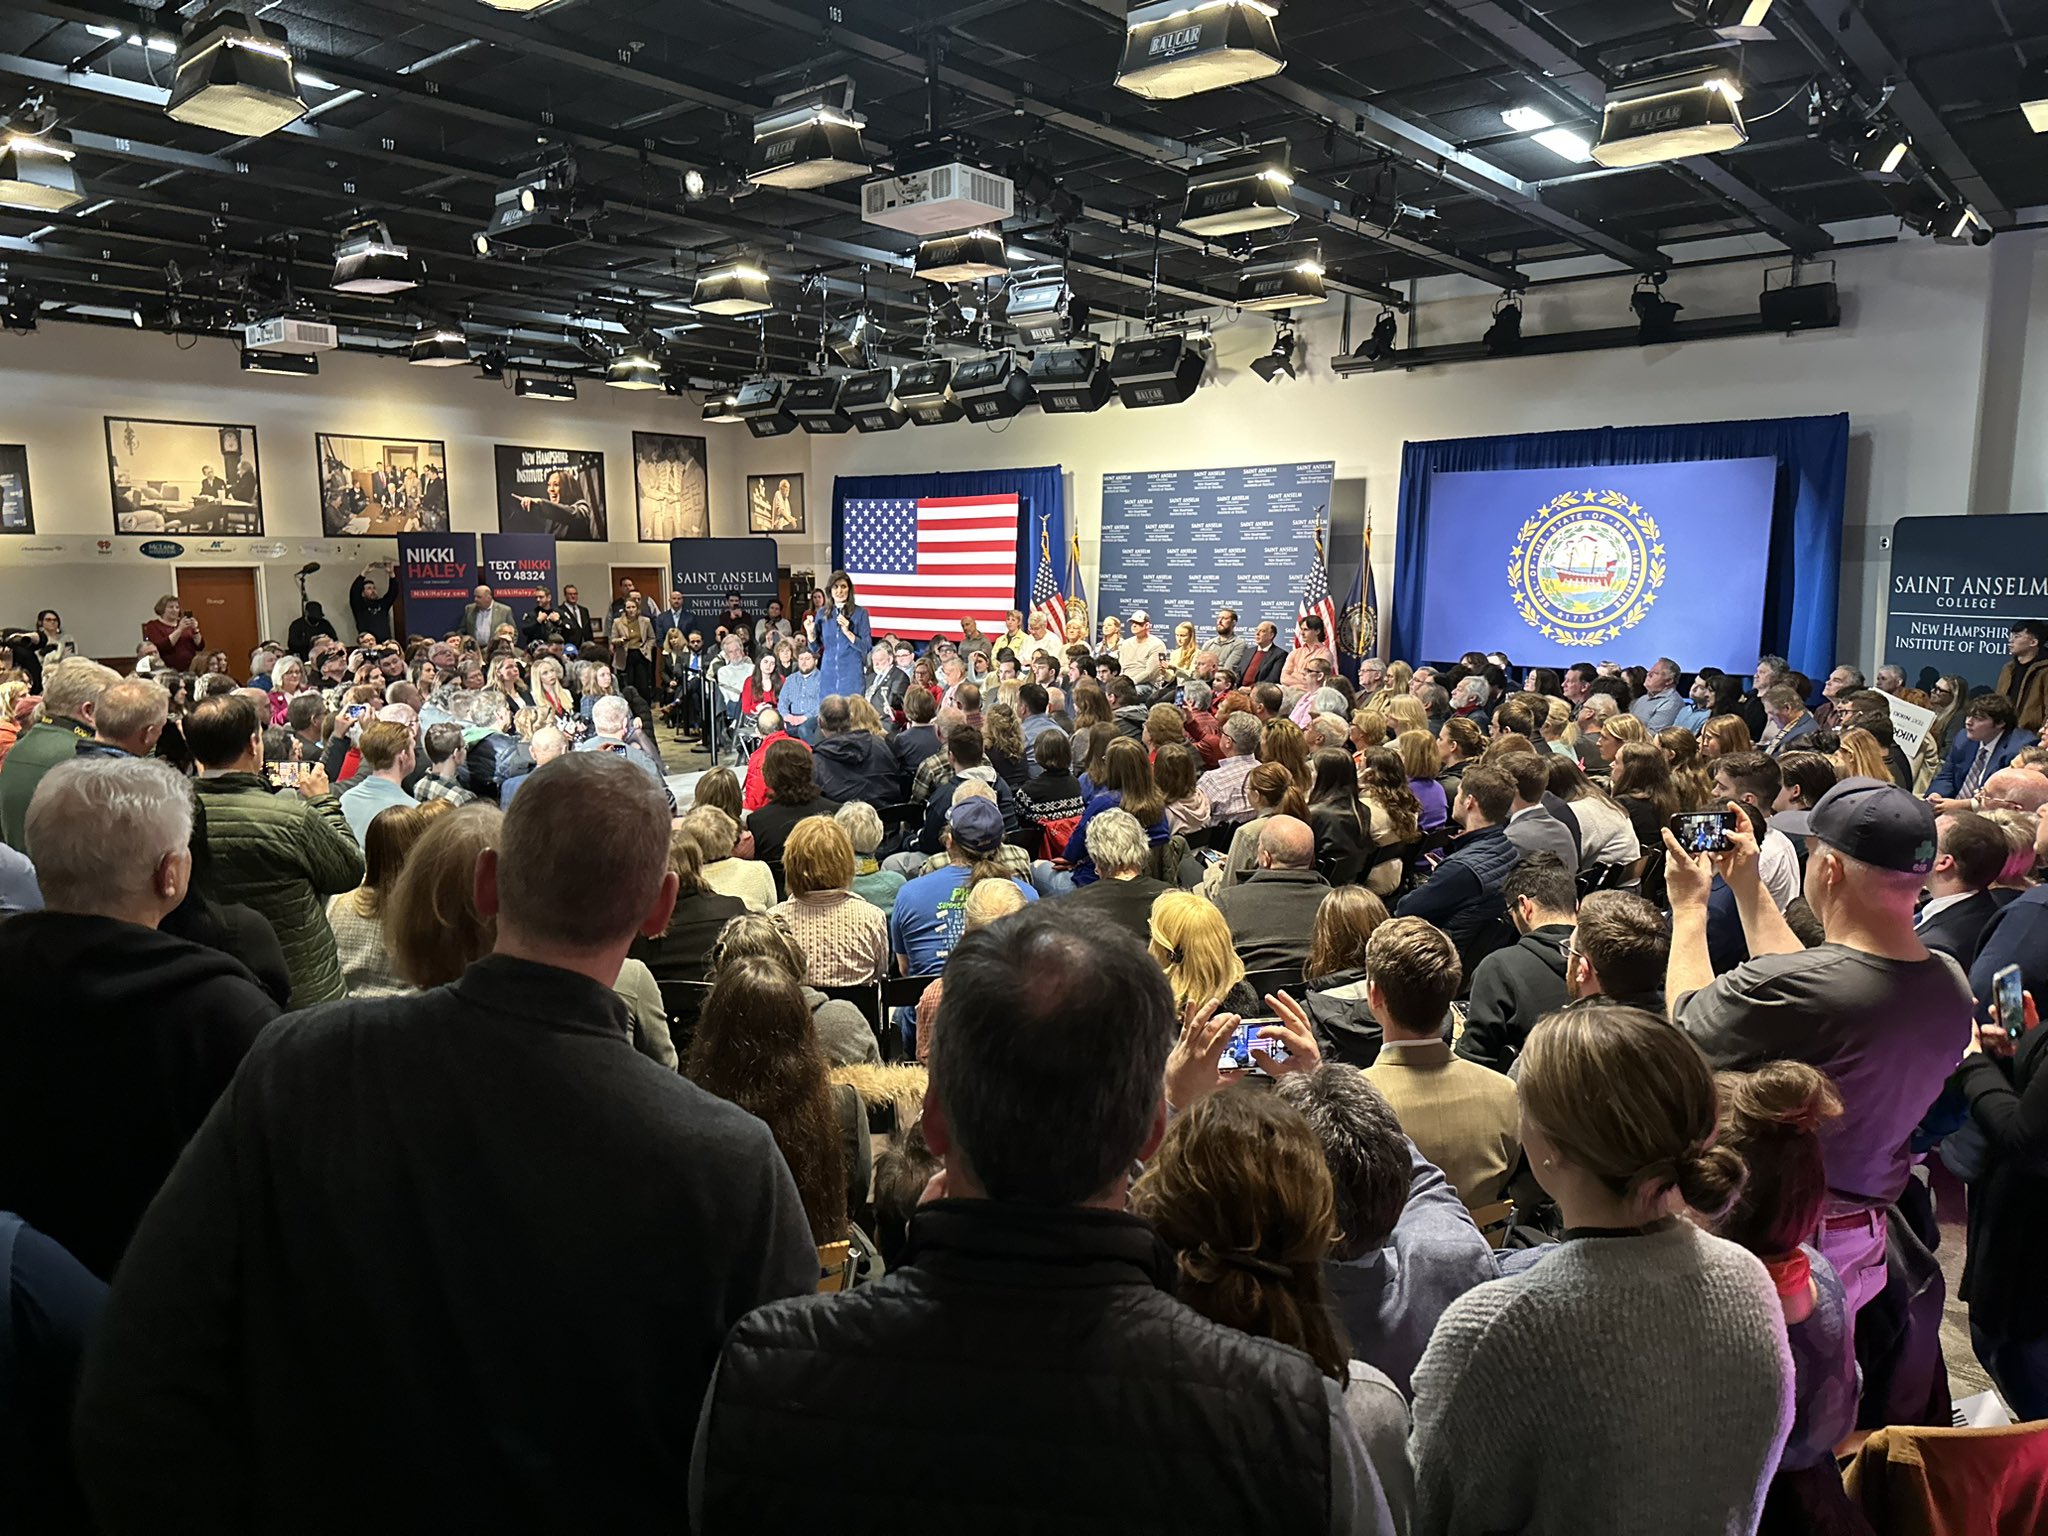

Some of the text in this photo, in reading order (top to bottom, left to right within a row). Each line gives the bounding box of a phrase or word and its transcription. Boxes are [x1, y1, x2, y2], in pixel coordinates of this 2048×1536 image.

[828, 6, 842, 24] 163
[1150, 26, 1200, 52] BALCAR
[618, 49, 631, 64] 147
[425, 80, 440, 94] 134
[1630, 104, 1682, 128] BALCAR
[382, 138, 395, 150] 117
[236, 162, 250, 174] 104
[344, 182, 356, 194] 103
[1134, 388, 1164, 400] BALCAR
[522, 452, 535, 466] NEW
[406, 548, 454, 564] NIKKI
[1530, 512, 1640, 609] SEAL OF THE STATE OF NEW HAMPSHIRE
[408, 564, 466, 578] HALEY
[488, 560, 550, 570] TEXT NIKKI
[496, 571, 546, 580] TO 48324
[677, 572, 773, 584] SAINT ANSELM
[1894, 576, 2048, 596] SAINT ANSELM
[1936, 596, 1996, 609] COLLEGE
[1910, 622, 2012, 639] NEW HAMPSHIR
[1895, 636, 2012, 655] INSTITUTE OF POLI
[1893, 727, 1918, 743] NIKK
